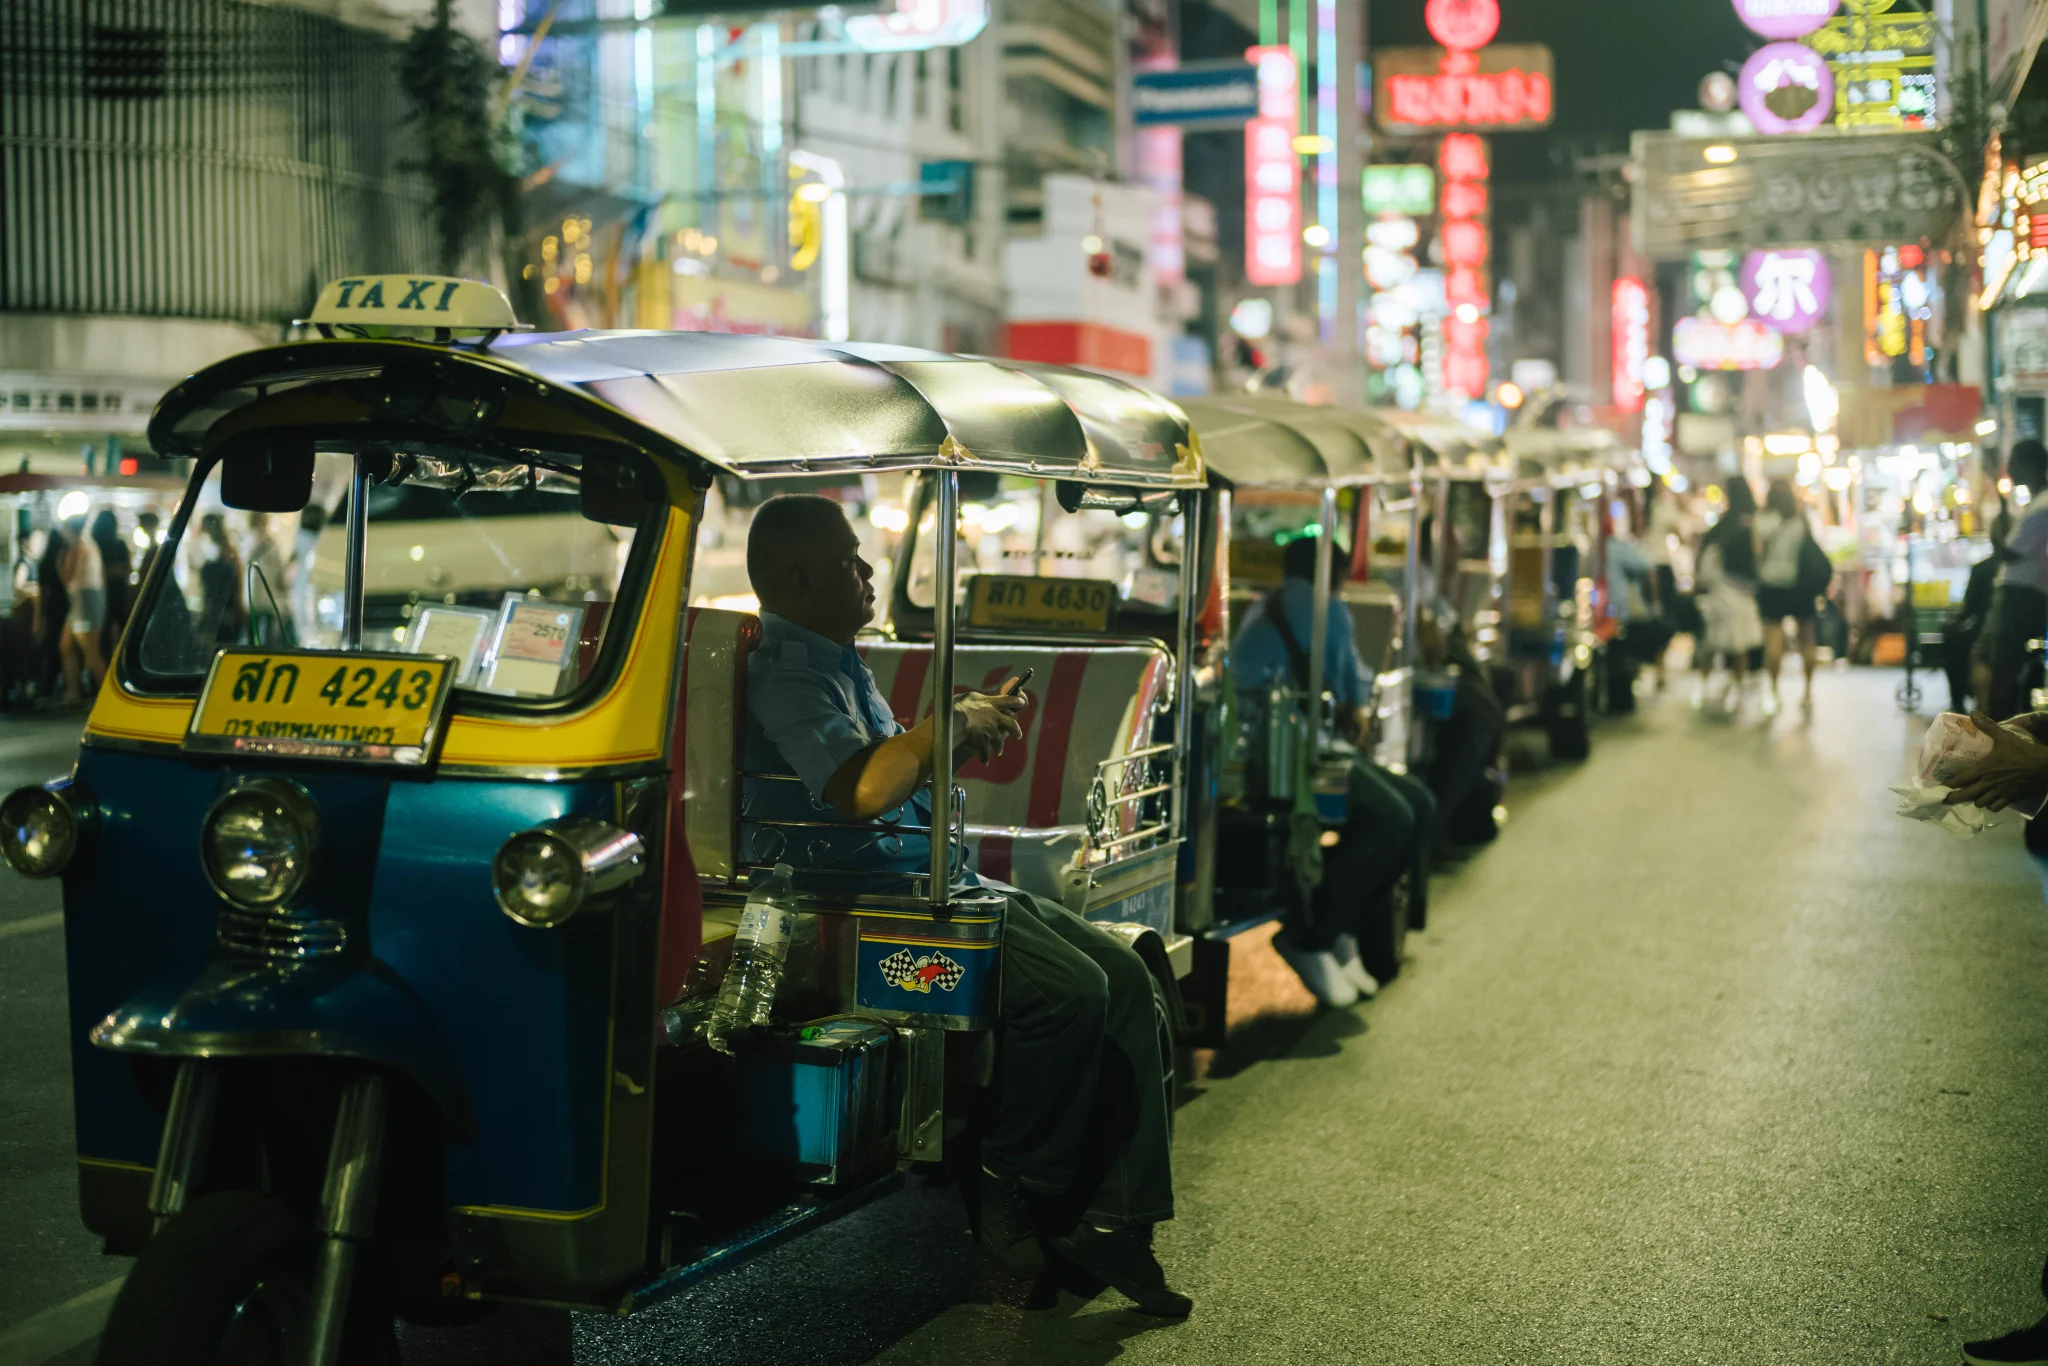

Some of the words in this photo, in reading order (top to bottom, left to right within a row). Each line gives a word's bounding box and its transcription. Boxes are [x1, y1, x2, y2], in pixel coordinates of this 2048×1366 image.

[336, 280, 460, 311] TAXI
[1040, 584, 1106, 612] 4630
[232, 658, 299, 704] สก
[320, 666, 432, 710] 4243
[224, 718, 396, 745] กรงเทพมหานคร
